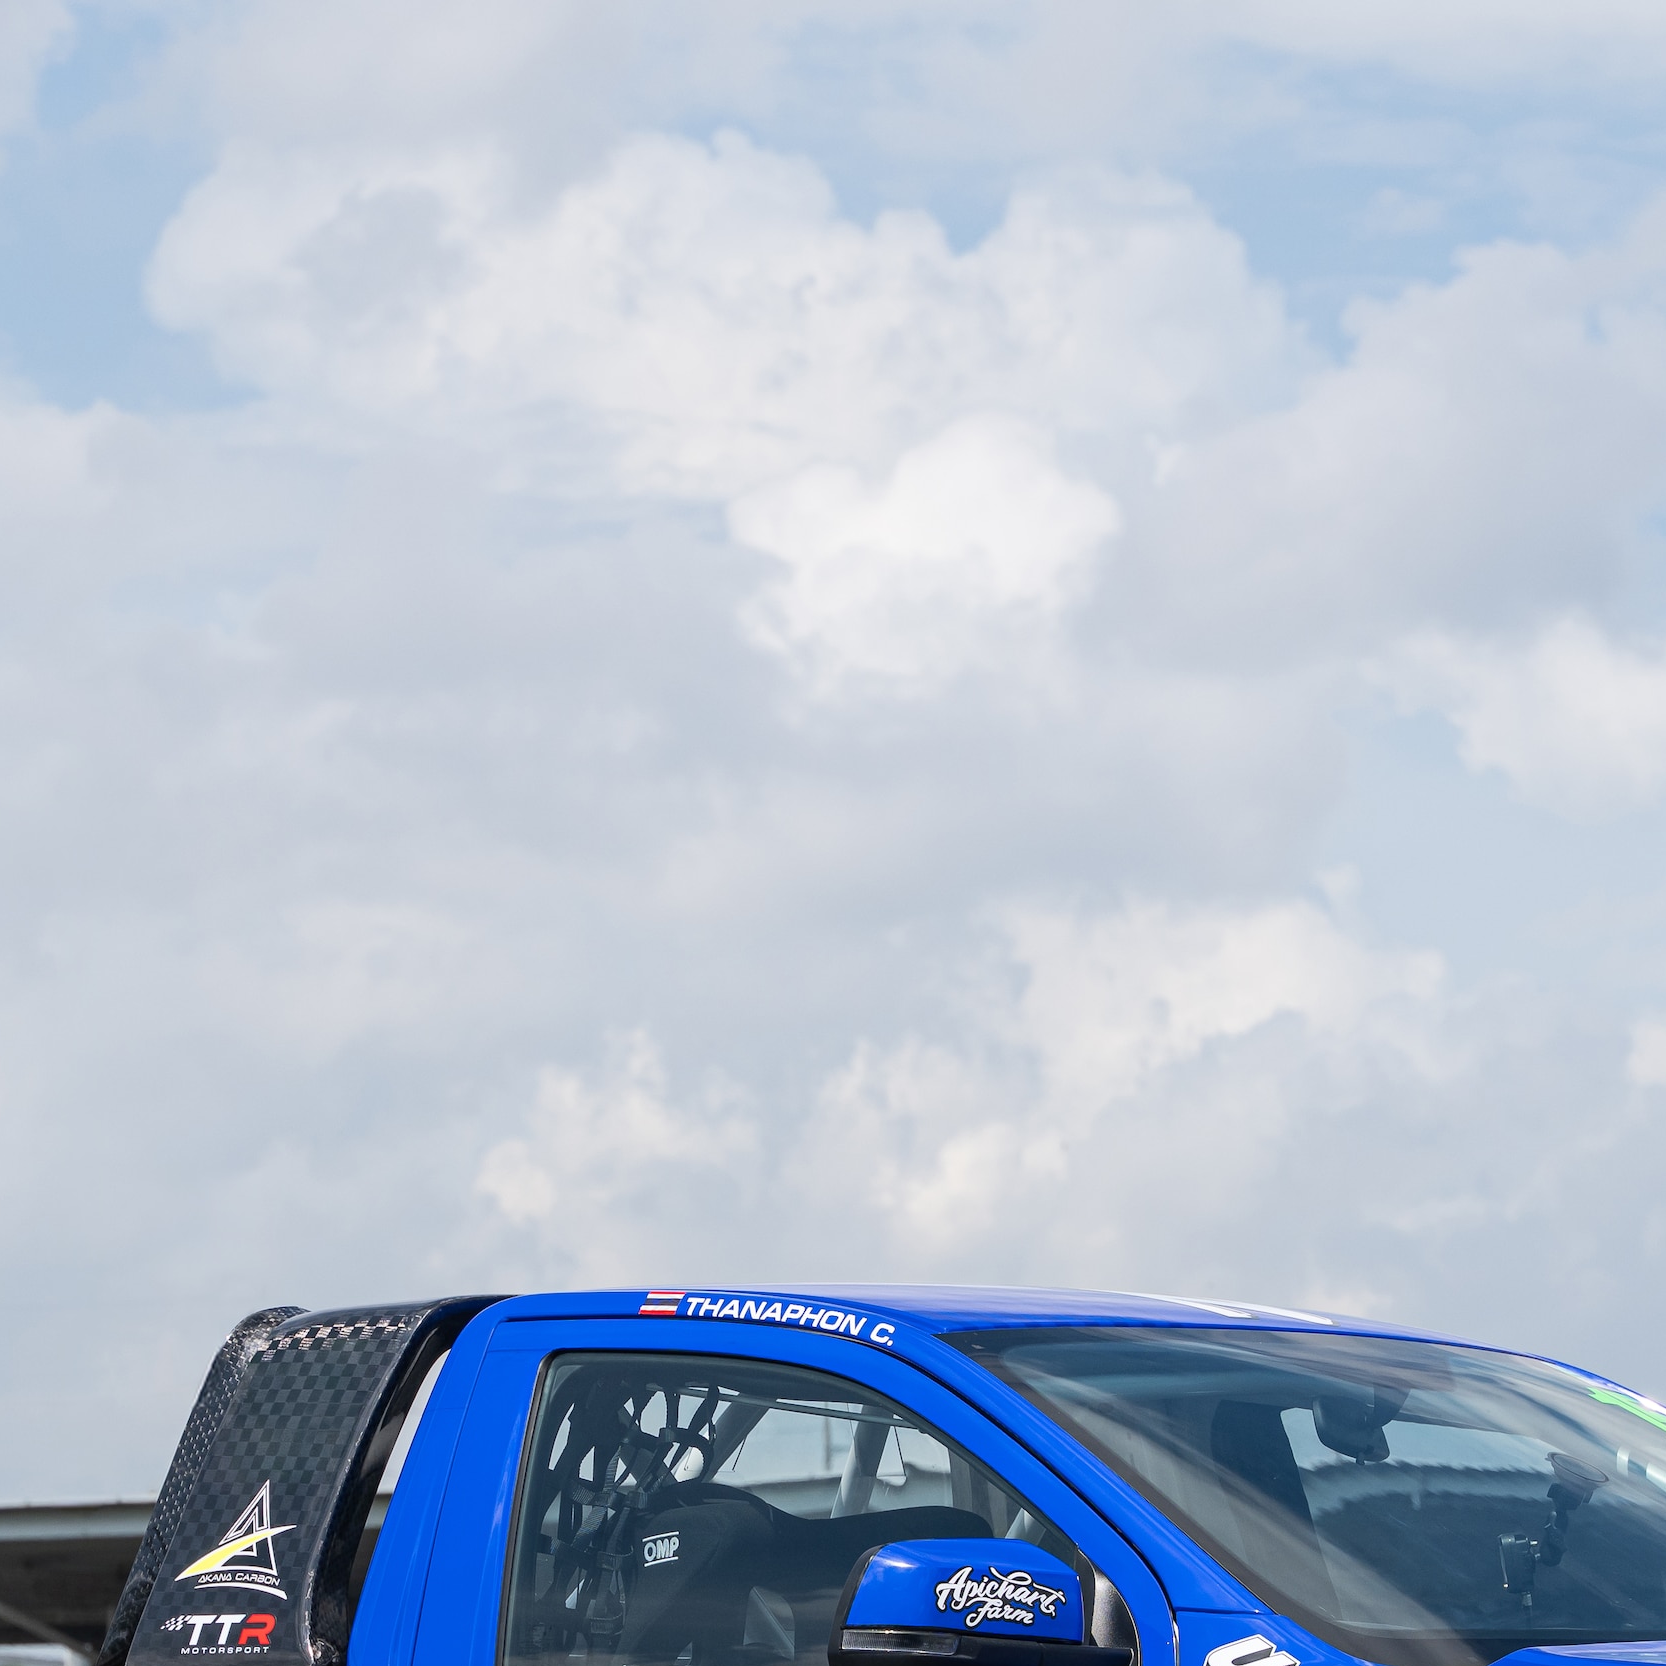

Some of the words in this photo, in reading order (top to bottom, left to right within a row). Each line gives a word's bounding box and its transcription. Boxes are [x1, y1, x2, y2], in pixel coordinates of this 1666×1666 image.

[686, 1296, 868, 1336] THANAPHON
[870, 1322, 895, 1346] C.
[643, 1536, 680, 1562] OMP
[197, 1573, 233, 1584] AKANA
[235, 1572, 281, 1586] CARBON
[936, 1567, 1066, 1617] Apichart
[965, 1597, 1035, 1628] Farm
[184, 1613, 277, 1646] TTR
[180, 1646, 270, 1655] MOTORSPORT
